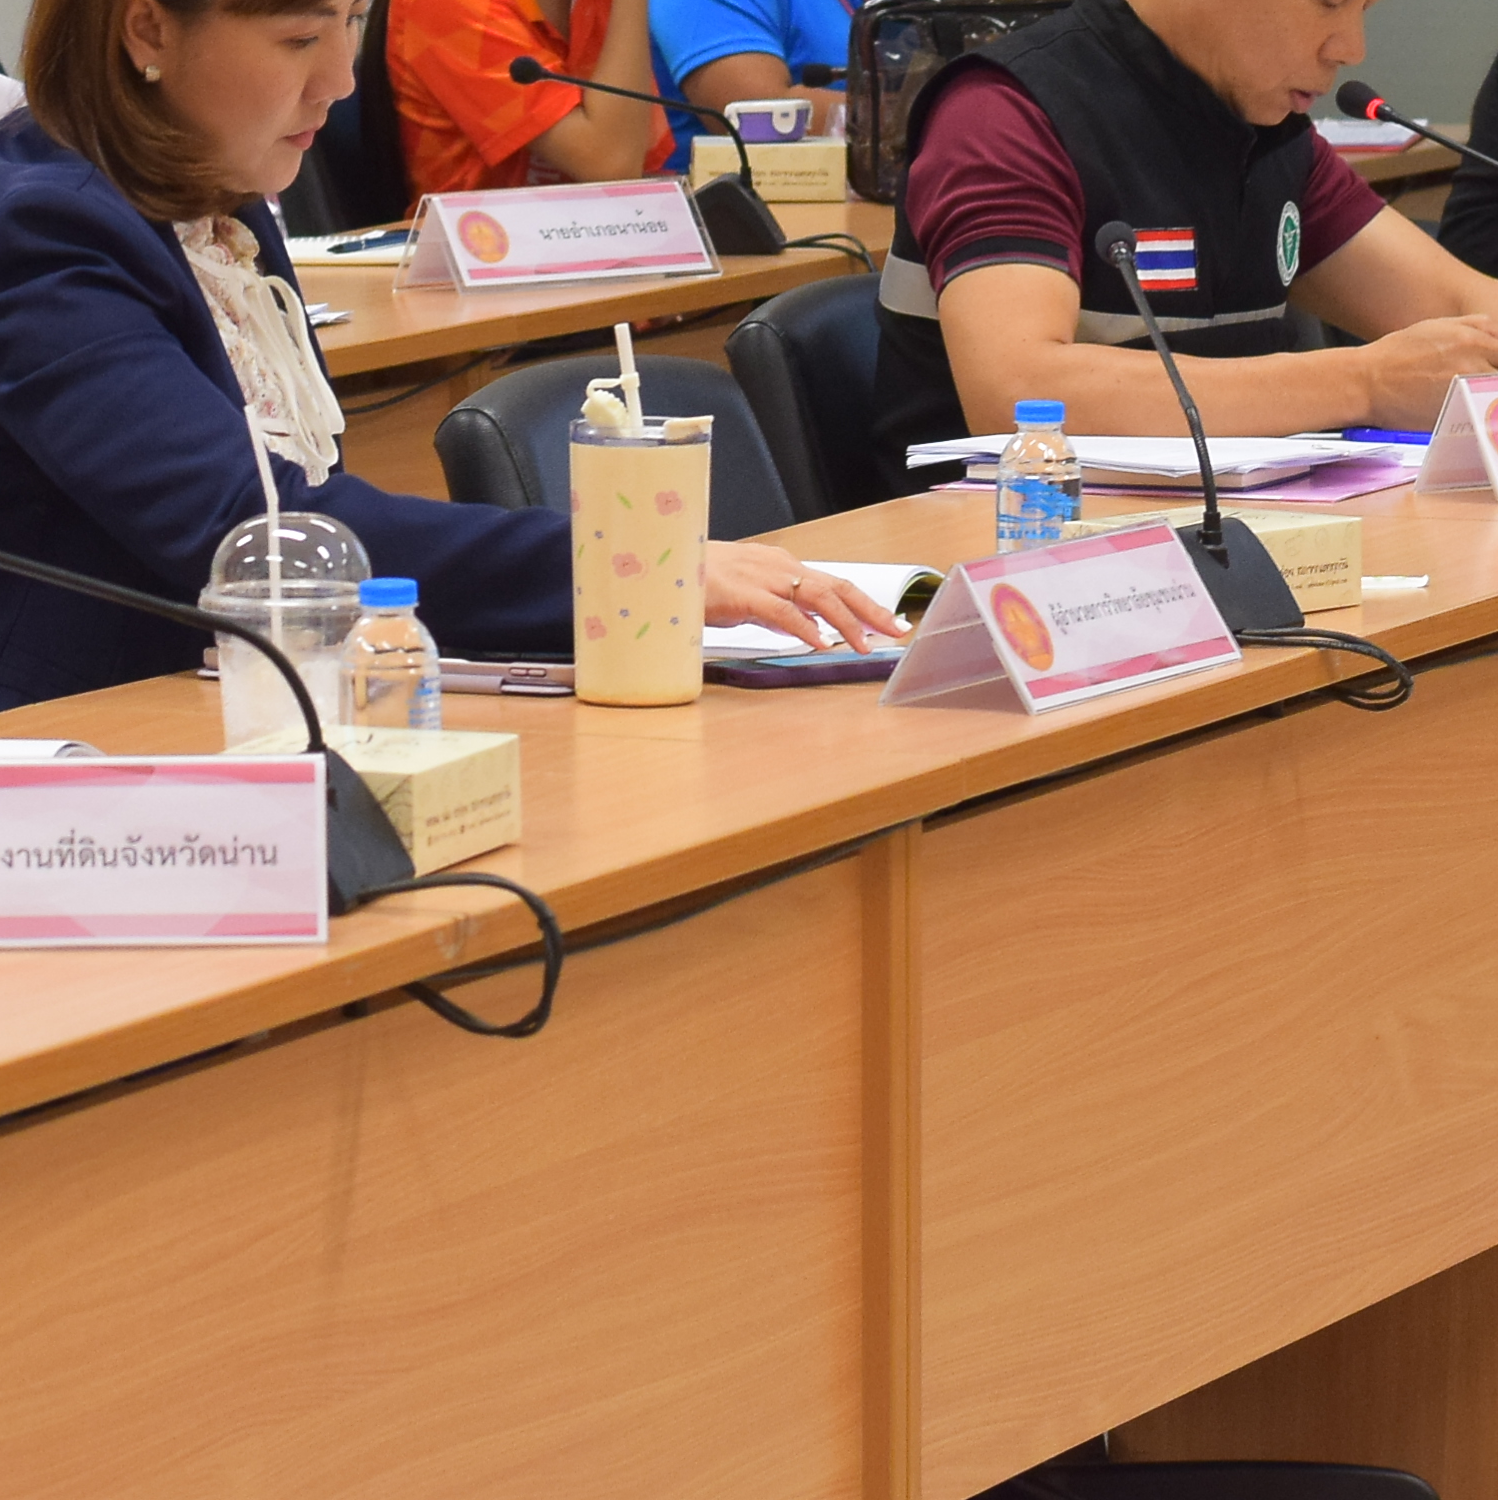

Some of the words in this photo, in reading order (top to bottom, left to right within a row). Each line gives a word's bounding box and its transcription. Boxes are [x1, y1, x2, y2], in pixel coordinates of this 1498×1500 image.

[539, 208, 669, 241] นายอำเภอนาน้อย
